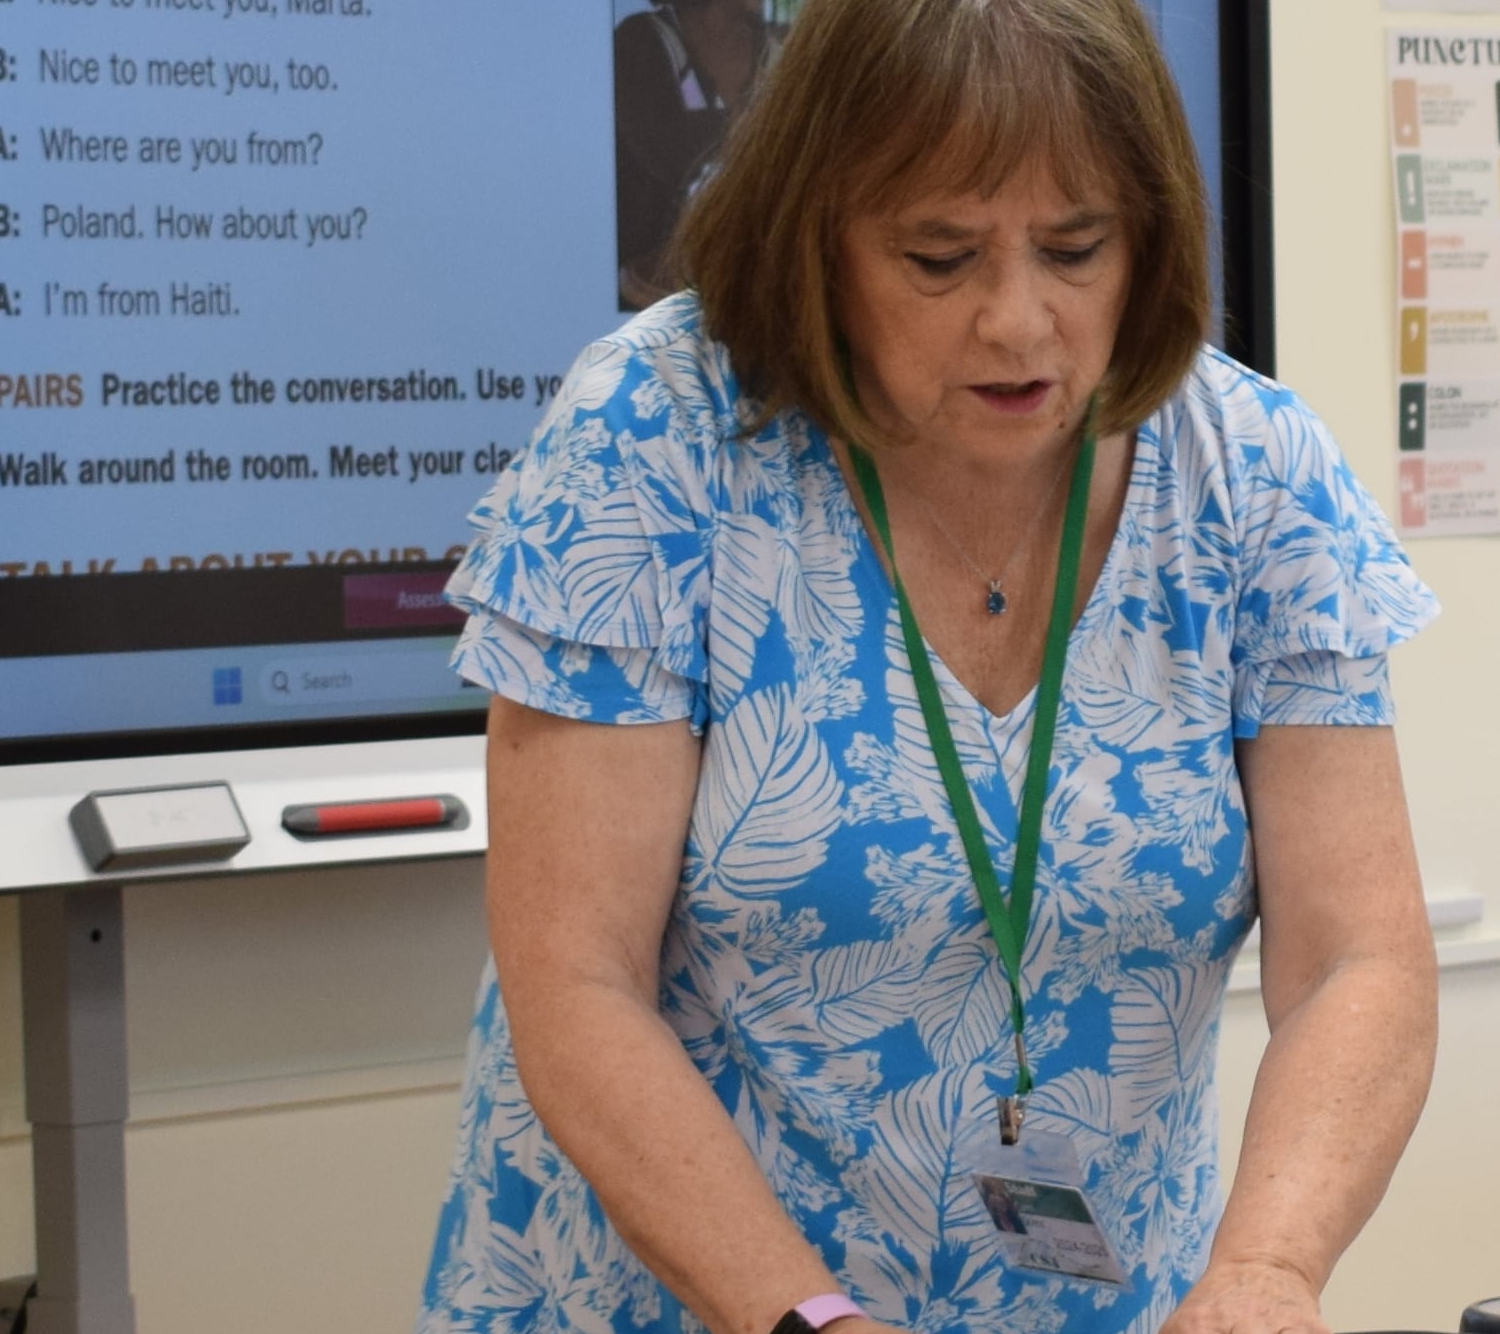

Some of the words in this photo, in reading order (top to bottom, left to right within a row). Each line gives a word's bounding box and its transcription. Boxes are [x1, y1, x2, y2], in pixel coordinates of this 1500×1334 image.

[39, 48, 100, 85] Nice
[108, 52, 138, 86] to
[147, 56, 217, 88] meet
[224, 61, 280, 97] you,
[285, 58, 339, 92] too.
[39, 127, 128, 164] Where
[138, 136, 182, 164] are
[190, 138, 237, 172] you
[245, 130, 324, 166] from?
[42, 203, 144, 240] Poland.
[155, 205, 213, 240] How
[221, 206, 299, 240] about
[305, 206, 368, 248] you?
[44, 281, 88, 316] I'm
[96, 281, 161, 317] from
[170, 282, 240, 317] Haiti.
[101, 371, 221, 407] Practice
[229, 371, 276, 405] the
[285, 368, 467, 404] conversation.
[476, 368, 525, 401] Use
[535, 375, 562, 407] yo
[77, 449, 175, 486] around
[184, 448, 231, 483] the
[241, 453, 319, 481] room.
[329, 444, 400, 478] Meet
[408, 450, 465, 484] your
[301, 670, 353, 692] Search
